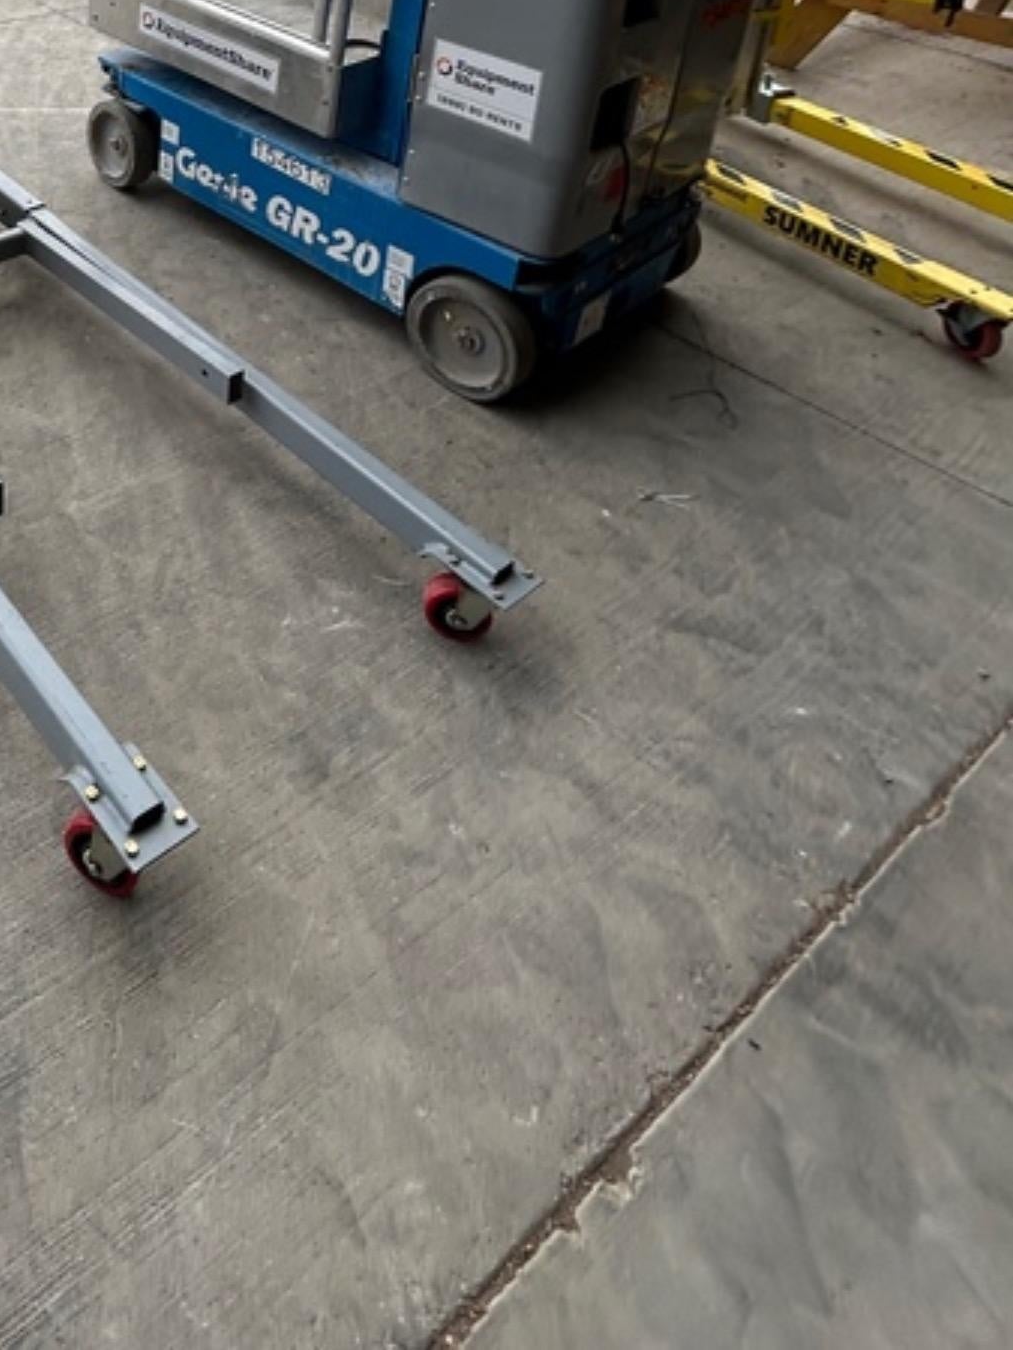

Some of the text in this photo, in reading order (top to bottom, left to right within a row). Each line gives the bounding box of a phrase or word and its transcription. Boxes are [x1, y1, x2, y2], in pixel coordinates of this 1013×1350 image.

[454, 71, 495, 96] Share
[456, 58, 534, 97] Equipment
[175, 145, 259, 213] Genie
[266, 194, 381, 278] GR-20
[762, 205, 879, 277] SUMNER
